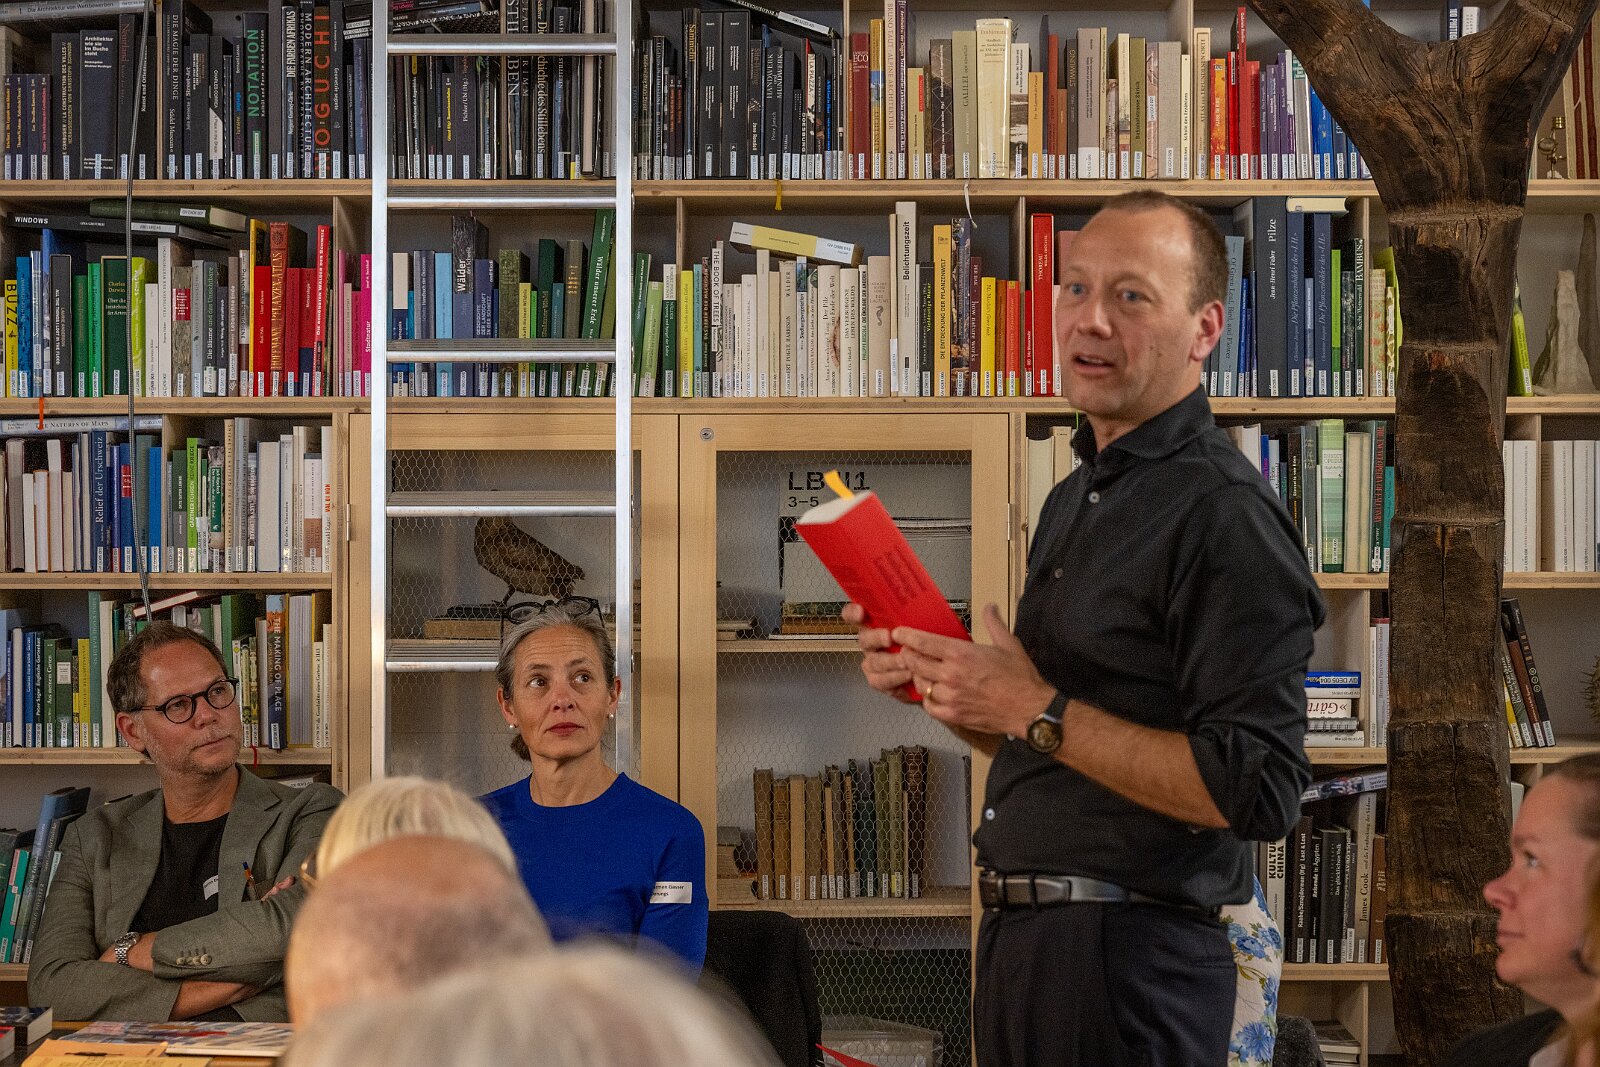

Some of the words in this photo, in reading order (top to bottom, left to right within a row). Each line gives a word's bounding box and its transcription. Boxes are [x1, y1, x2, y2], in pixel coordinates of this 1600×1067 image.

[248, 29, 259, 117] NOTATION
[1268, 219, 1276, 242] Pilze
[903, 222, 911, 280] Belichtungszeit
[6, 283, 17, 325] BUZZ
[713, 287, 720, 296] OF
[95, 436, 104, 480] Urschweiz
[95, 498, 104, 523] Relief
[274, 674, 282, 684] OF
[1360, 873, 1370, 895] Cook
